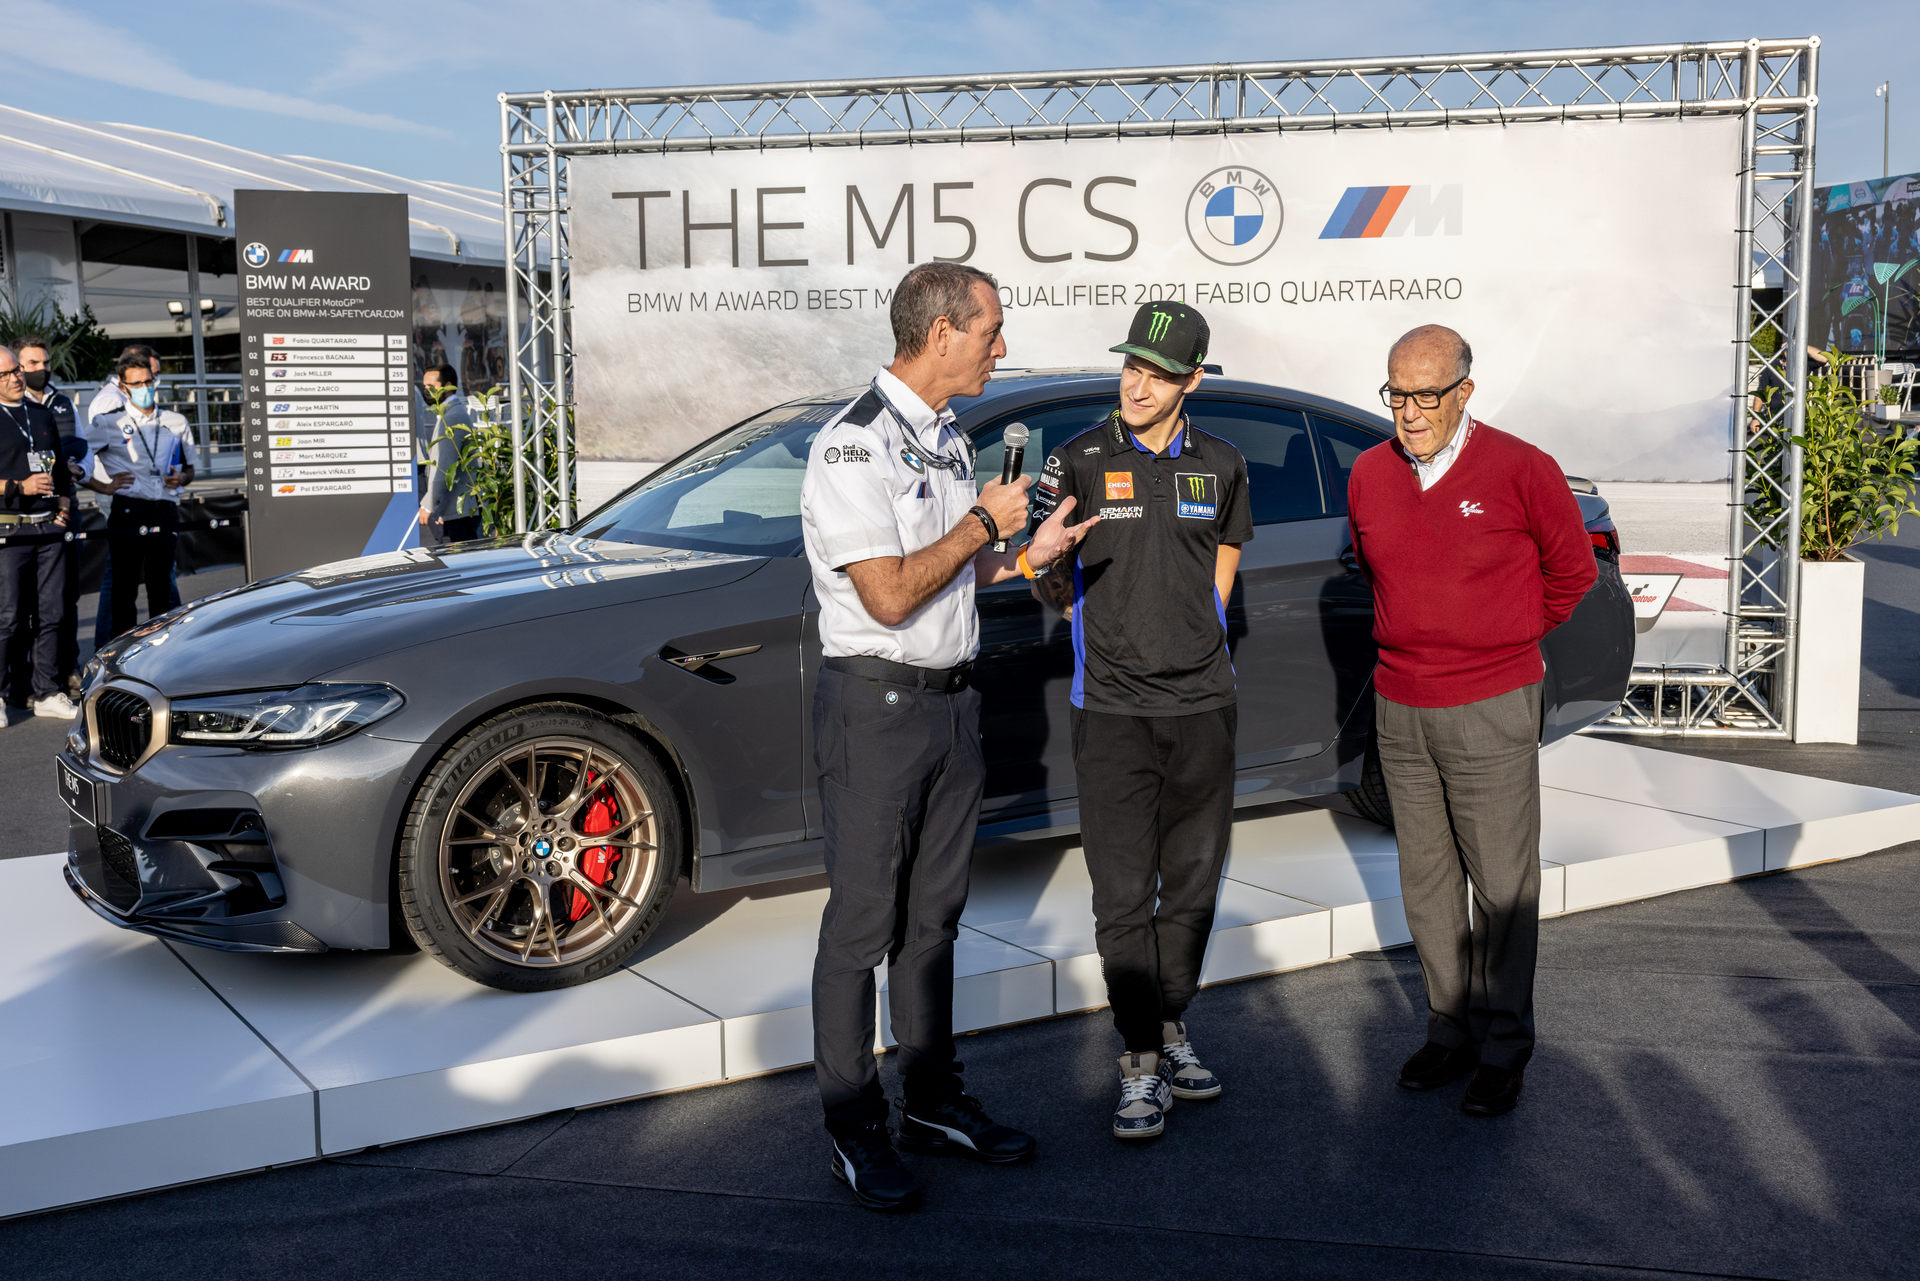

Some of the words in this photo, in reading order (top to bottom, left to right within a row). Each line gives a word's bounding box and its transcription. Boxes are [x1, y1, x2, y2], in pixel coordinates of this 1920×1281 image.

[1199, 170, 1271, 199] BMW
[612, 186, 808, 269] THE
[846, 181, 977, 266] M5
[1018, 176, 1139, 263] CS
[245, 274, 288, 290] BMW
[291, 275, 306, 290] M
[310, 275, 371, 291] AWARD
[628, 292, 682, 313] BMW
[690, 292, 708, 312] M
[715, 290, 798, 311] AWARD
[808, 288, 867, 310] BEST
[999, 284, 1127, 309] QUALIFIER
[1134, 283, 1186, 304] 2021
[1196, 281, 1271, 304] FABIO
[1280, 277, 1463, 305] QUARTARARO
[246, 297, 271, 307] BEST
[272, 297, 321, 307] QUALIFIER
[246, 309, 275, 318] MORE
[276, 309, 291, 318] ON
[293, 309, 404, 318] BMW-M-SAFETYCAR.COM
[248, 352, 258, 360] 02
[250, 385, 260, 393] 04
[273, 403, 290, 412] 89
[251, 418, 262, 426] 06
[254, 467, 264, 475] 09
[1107, 481, 1132, 489] ENEOS
[1099, 505, 1143, 514] SEMAKIN
[1189, 504, 1215, 514] YAMAHA
[443, 726, 518, 794] MICHELIN
